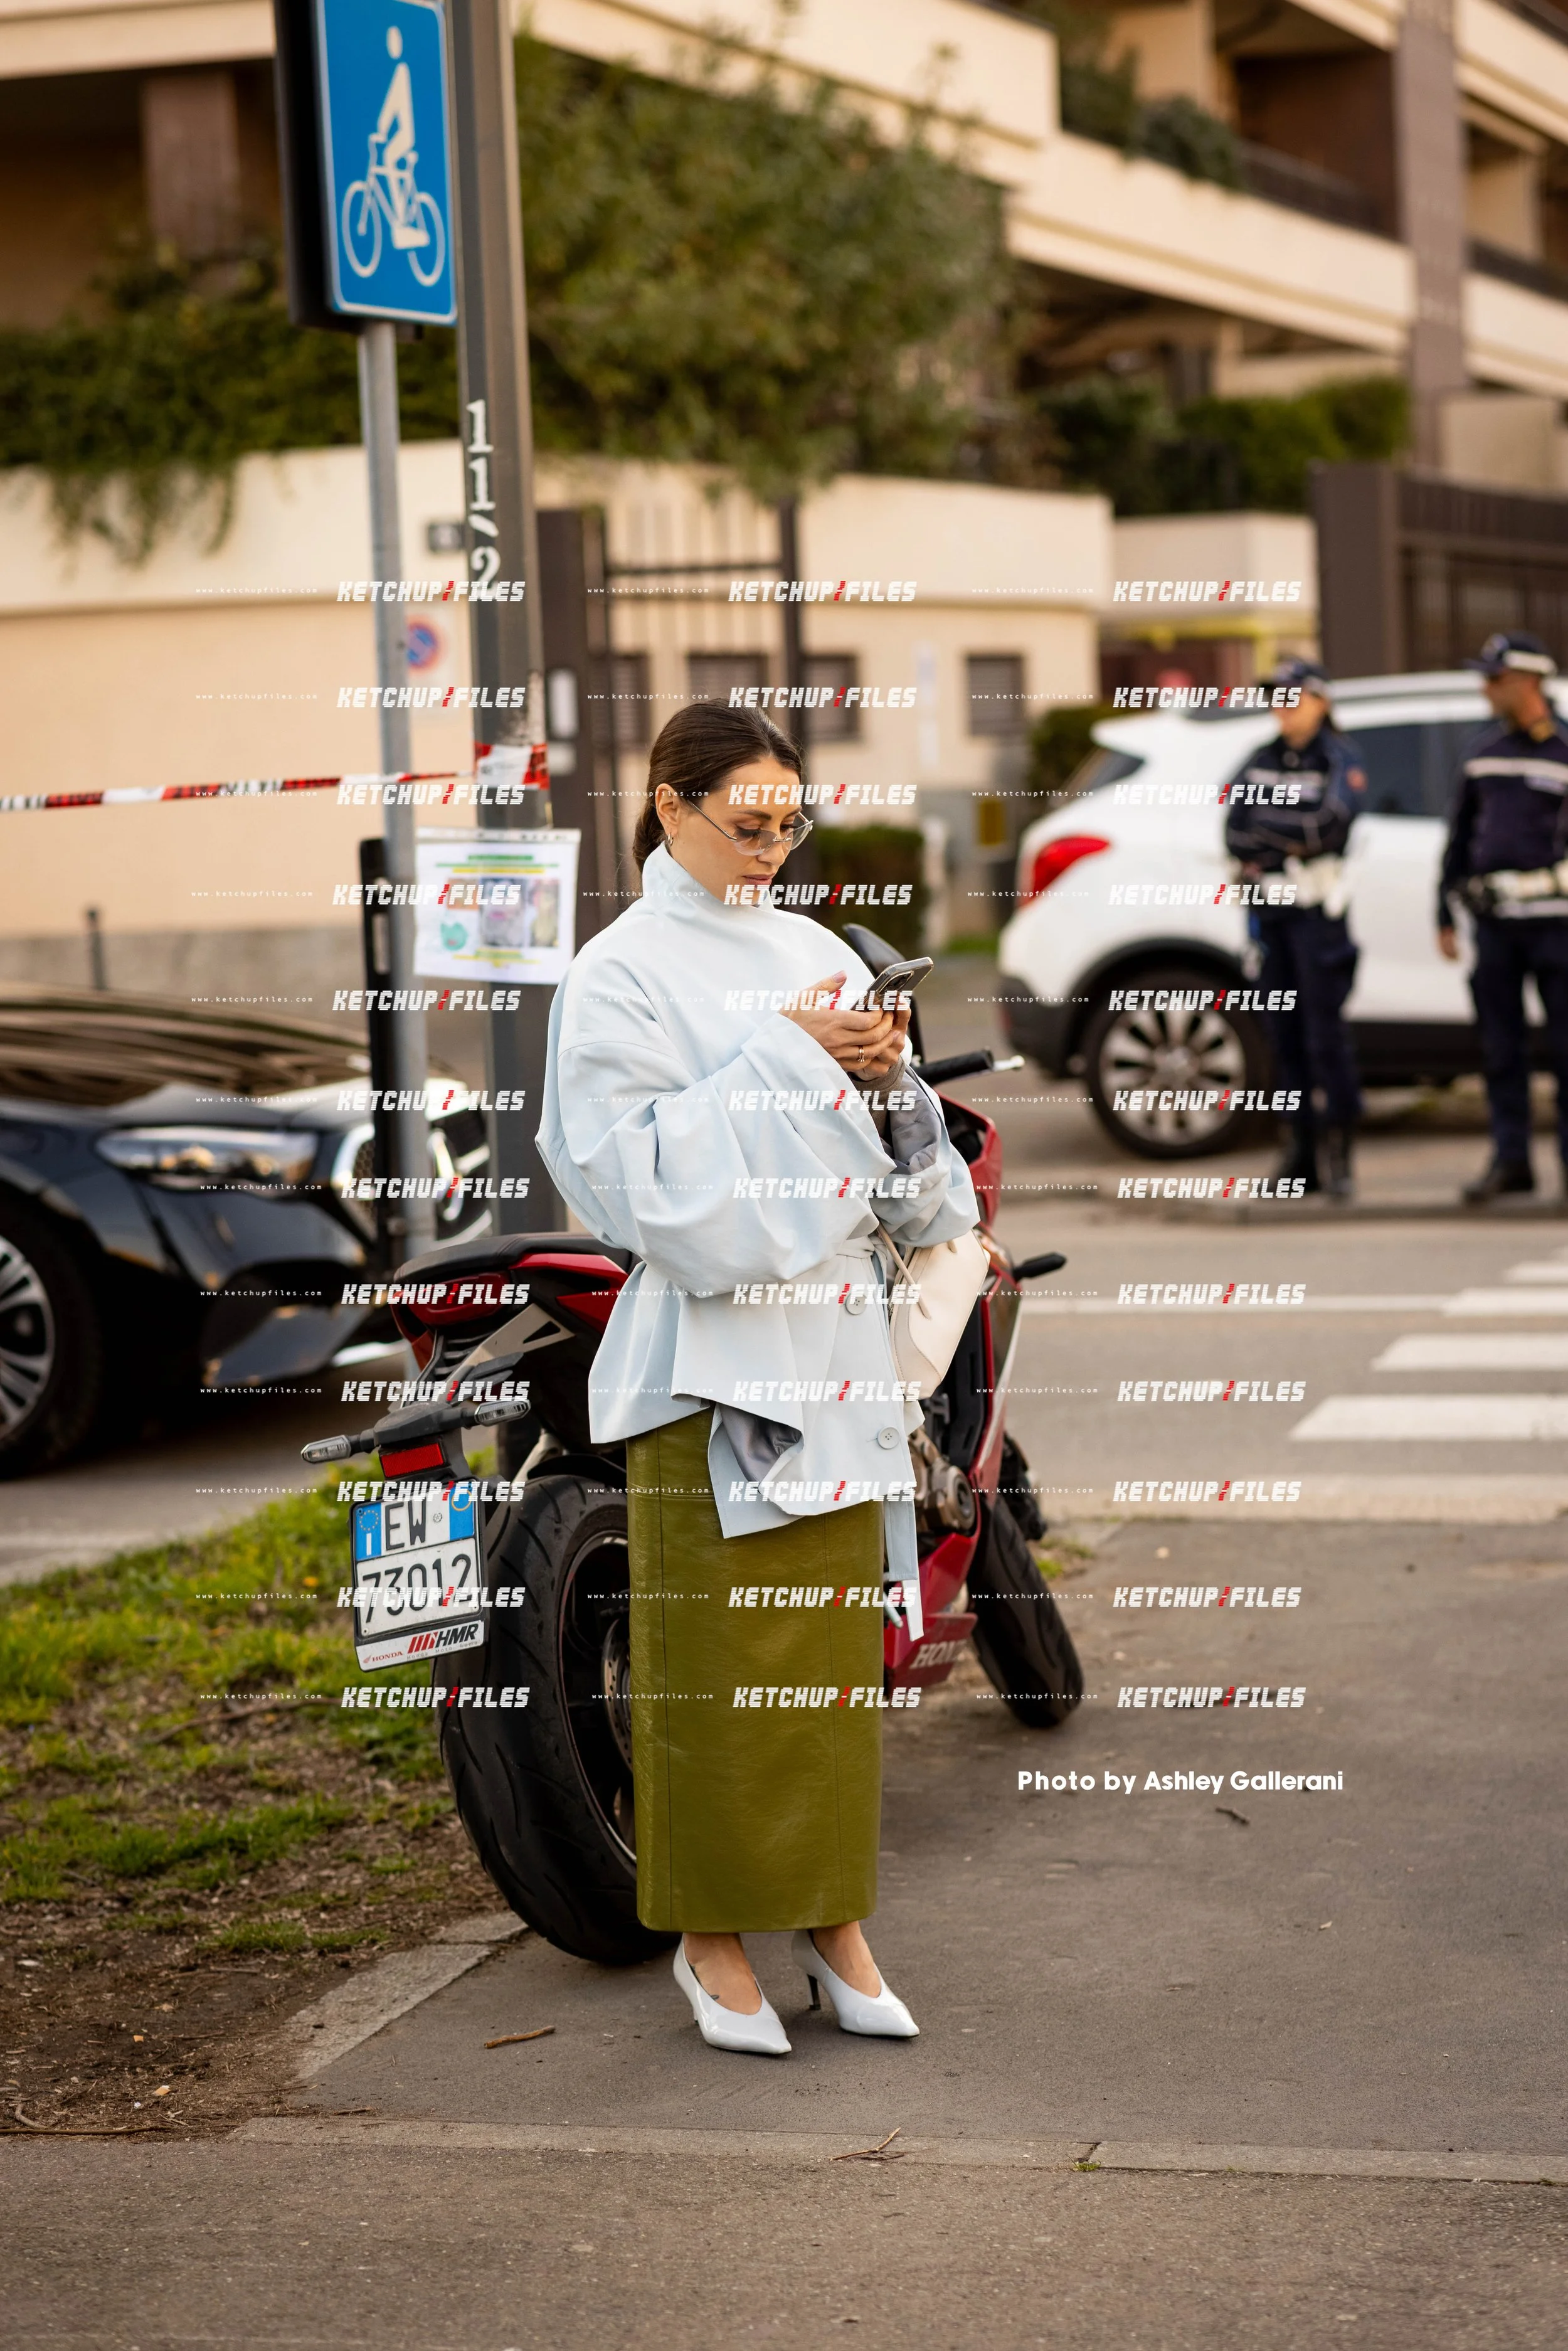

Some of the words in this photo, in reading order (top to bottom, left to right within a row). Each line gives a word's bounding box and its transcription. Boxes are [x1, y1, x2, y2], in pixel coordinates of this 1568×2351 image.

[385, 1499, 426, 1551] EW
[363, 1553, 472, 1623] 73012
[435, 1623, 479, 1648] HMR
[371, 1650, 403, 1662] HONDA
